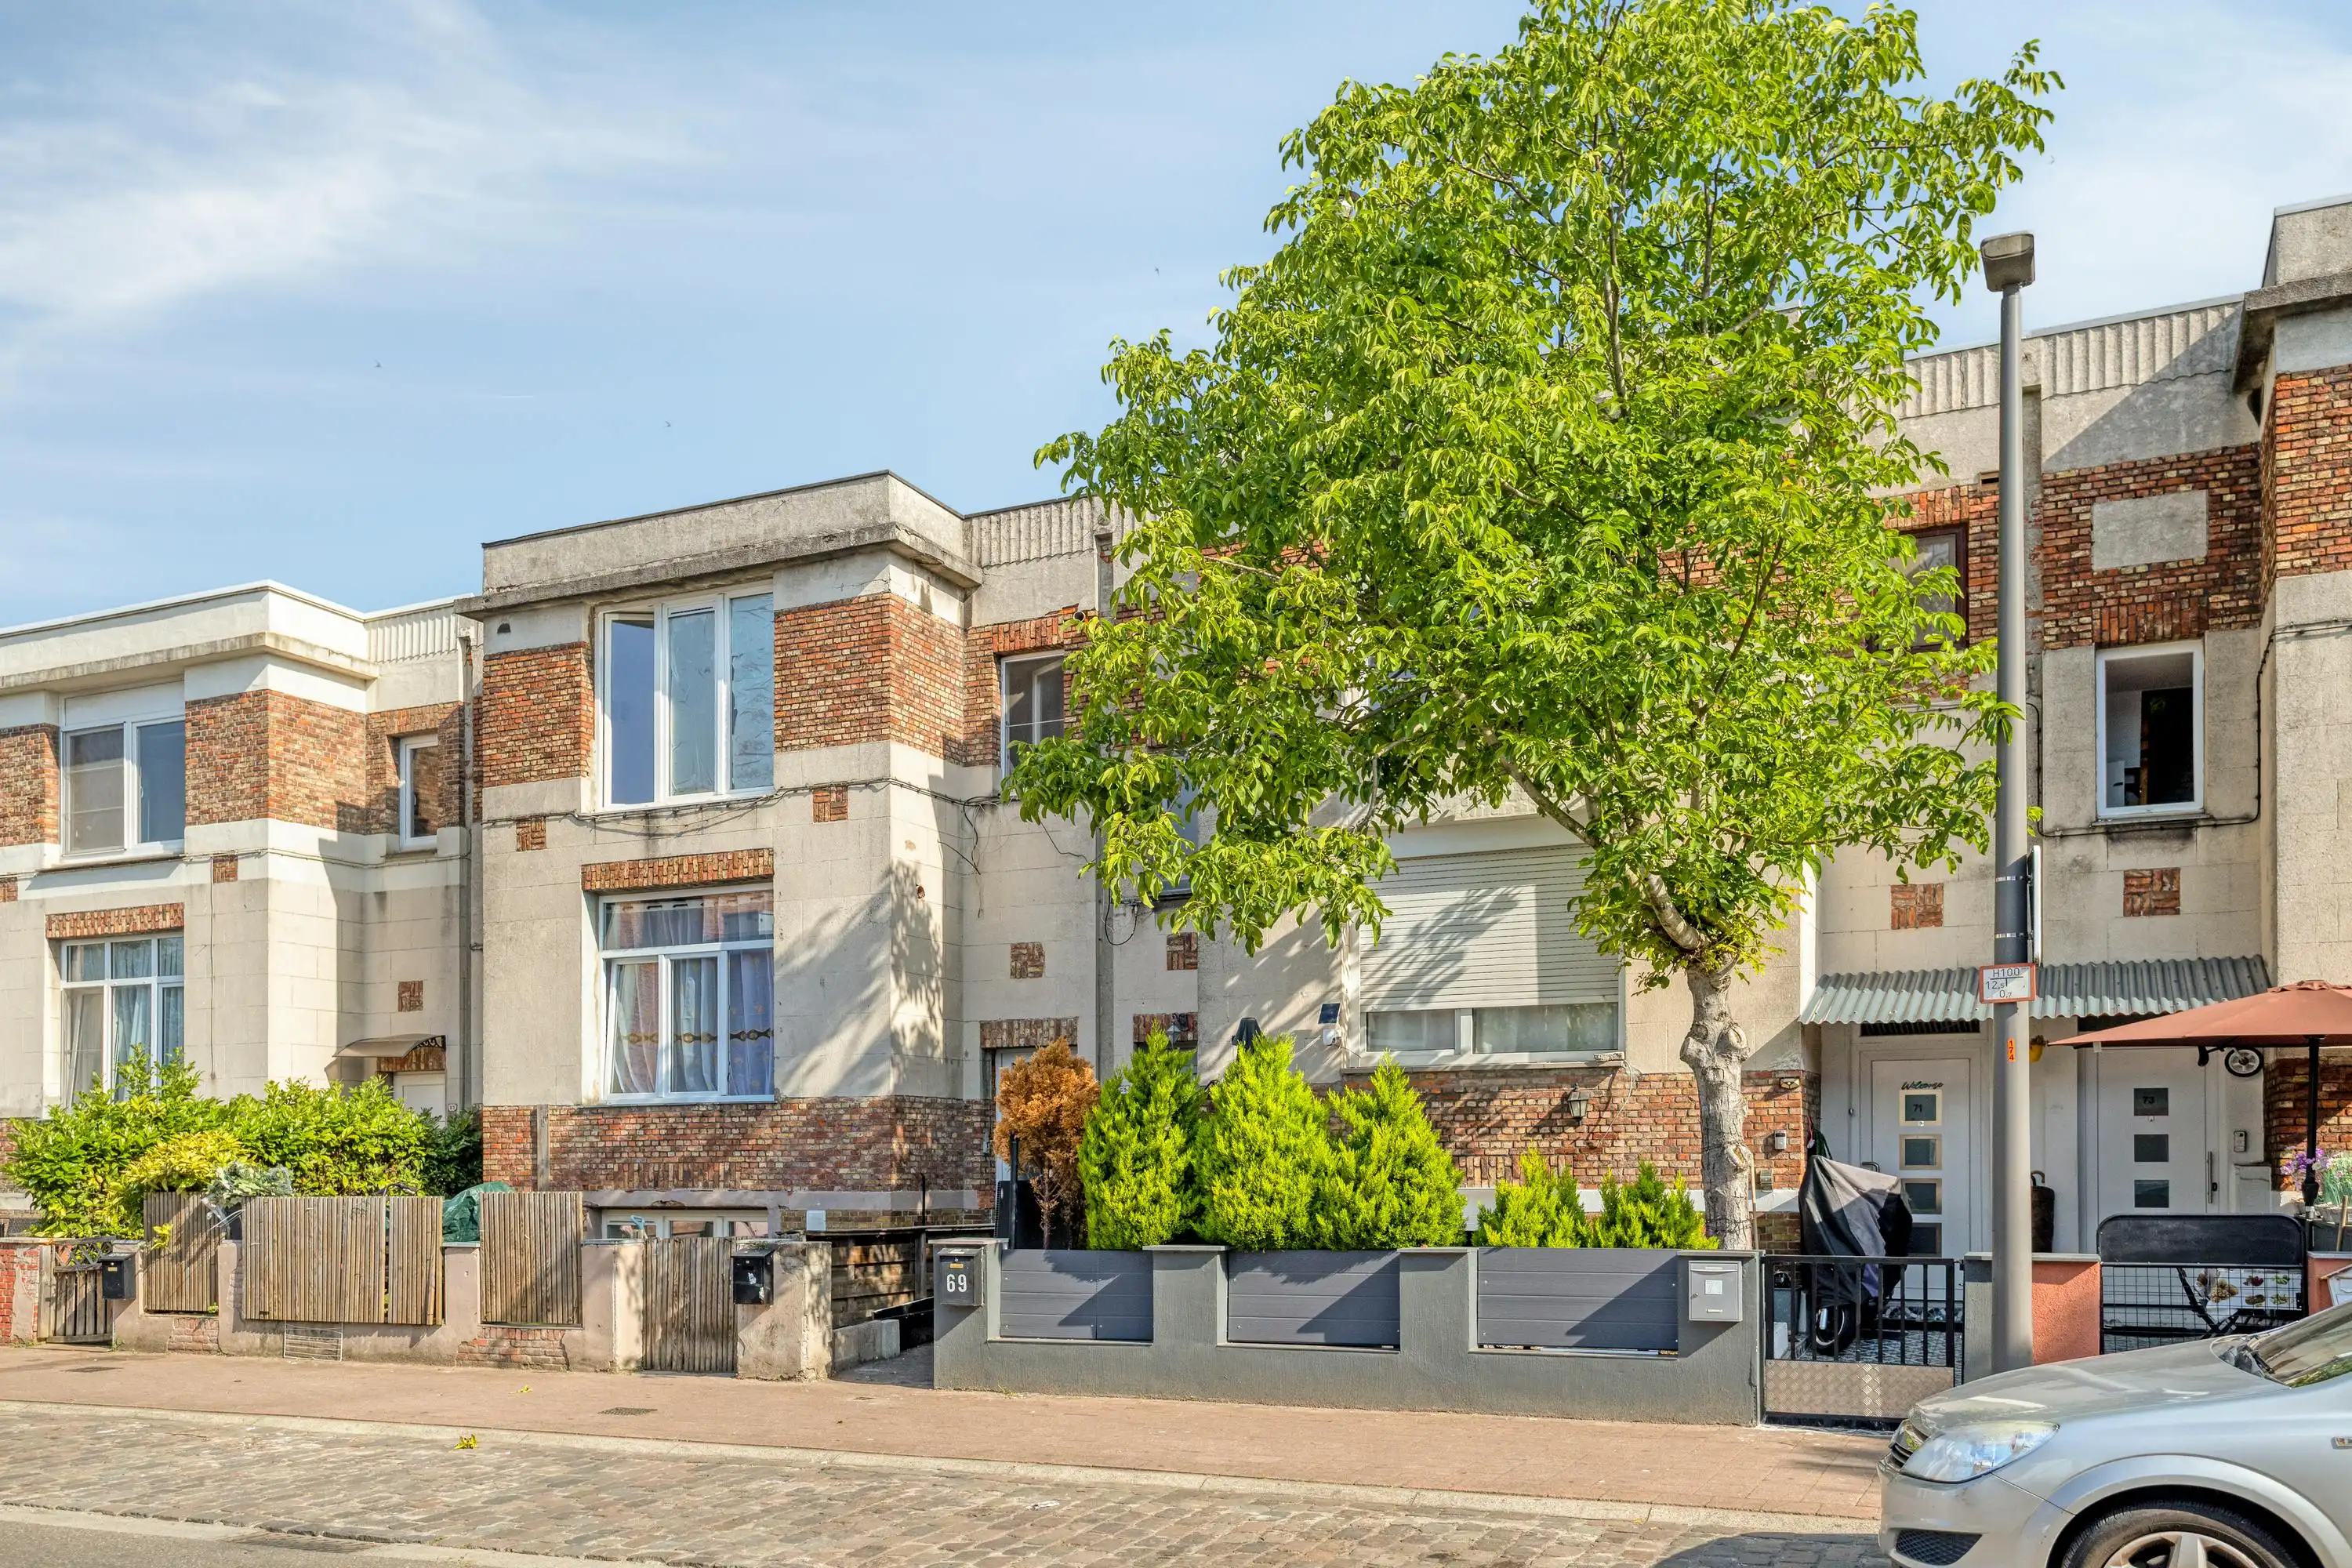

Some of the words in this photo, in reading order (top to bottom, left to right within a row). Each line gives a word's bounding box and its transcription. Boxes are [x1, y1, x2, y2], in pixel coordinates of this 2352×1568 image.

[1993, 968, 2020, 977] H100
[1913, 1103, 1922, 1112] 71
[946, 1274, 967, 1293] 69
